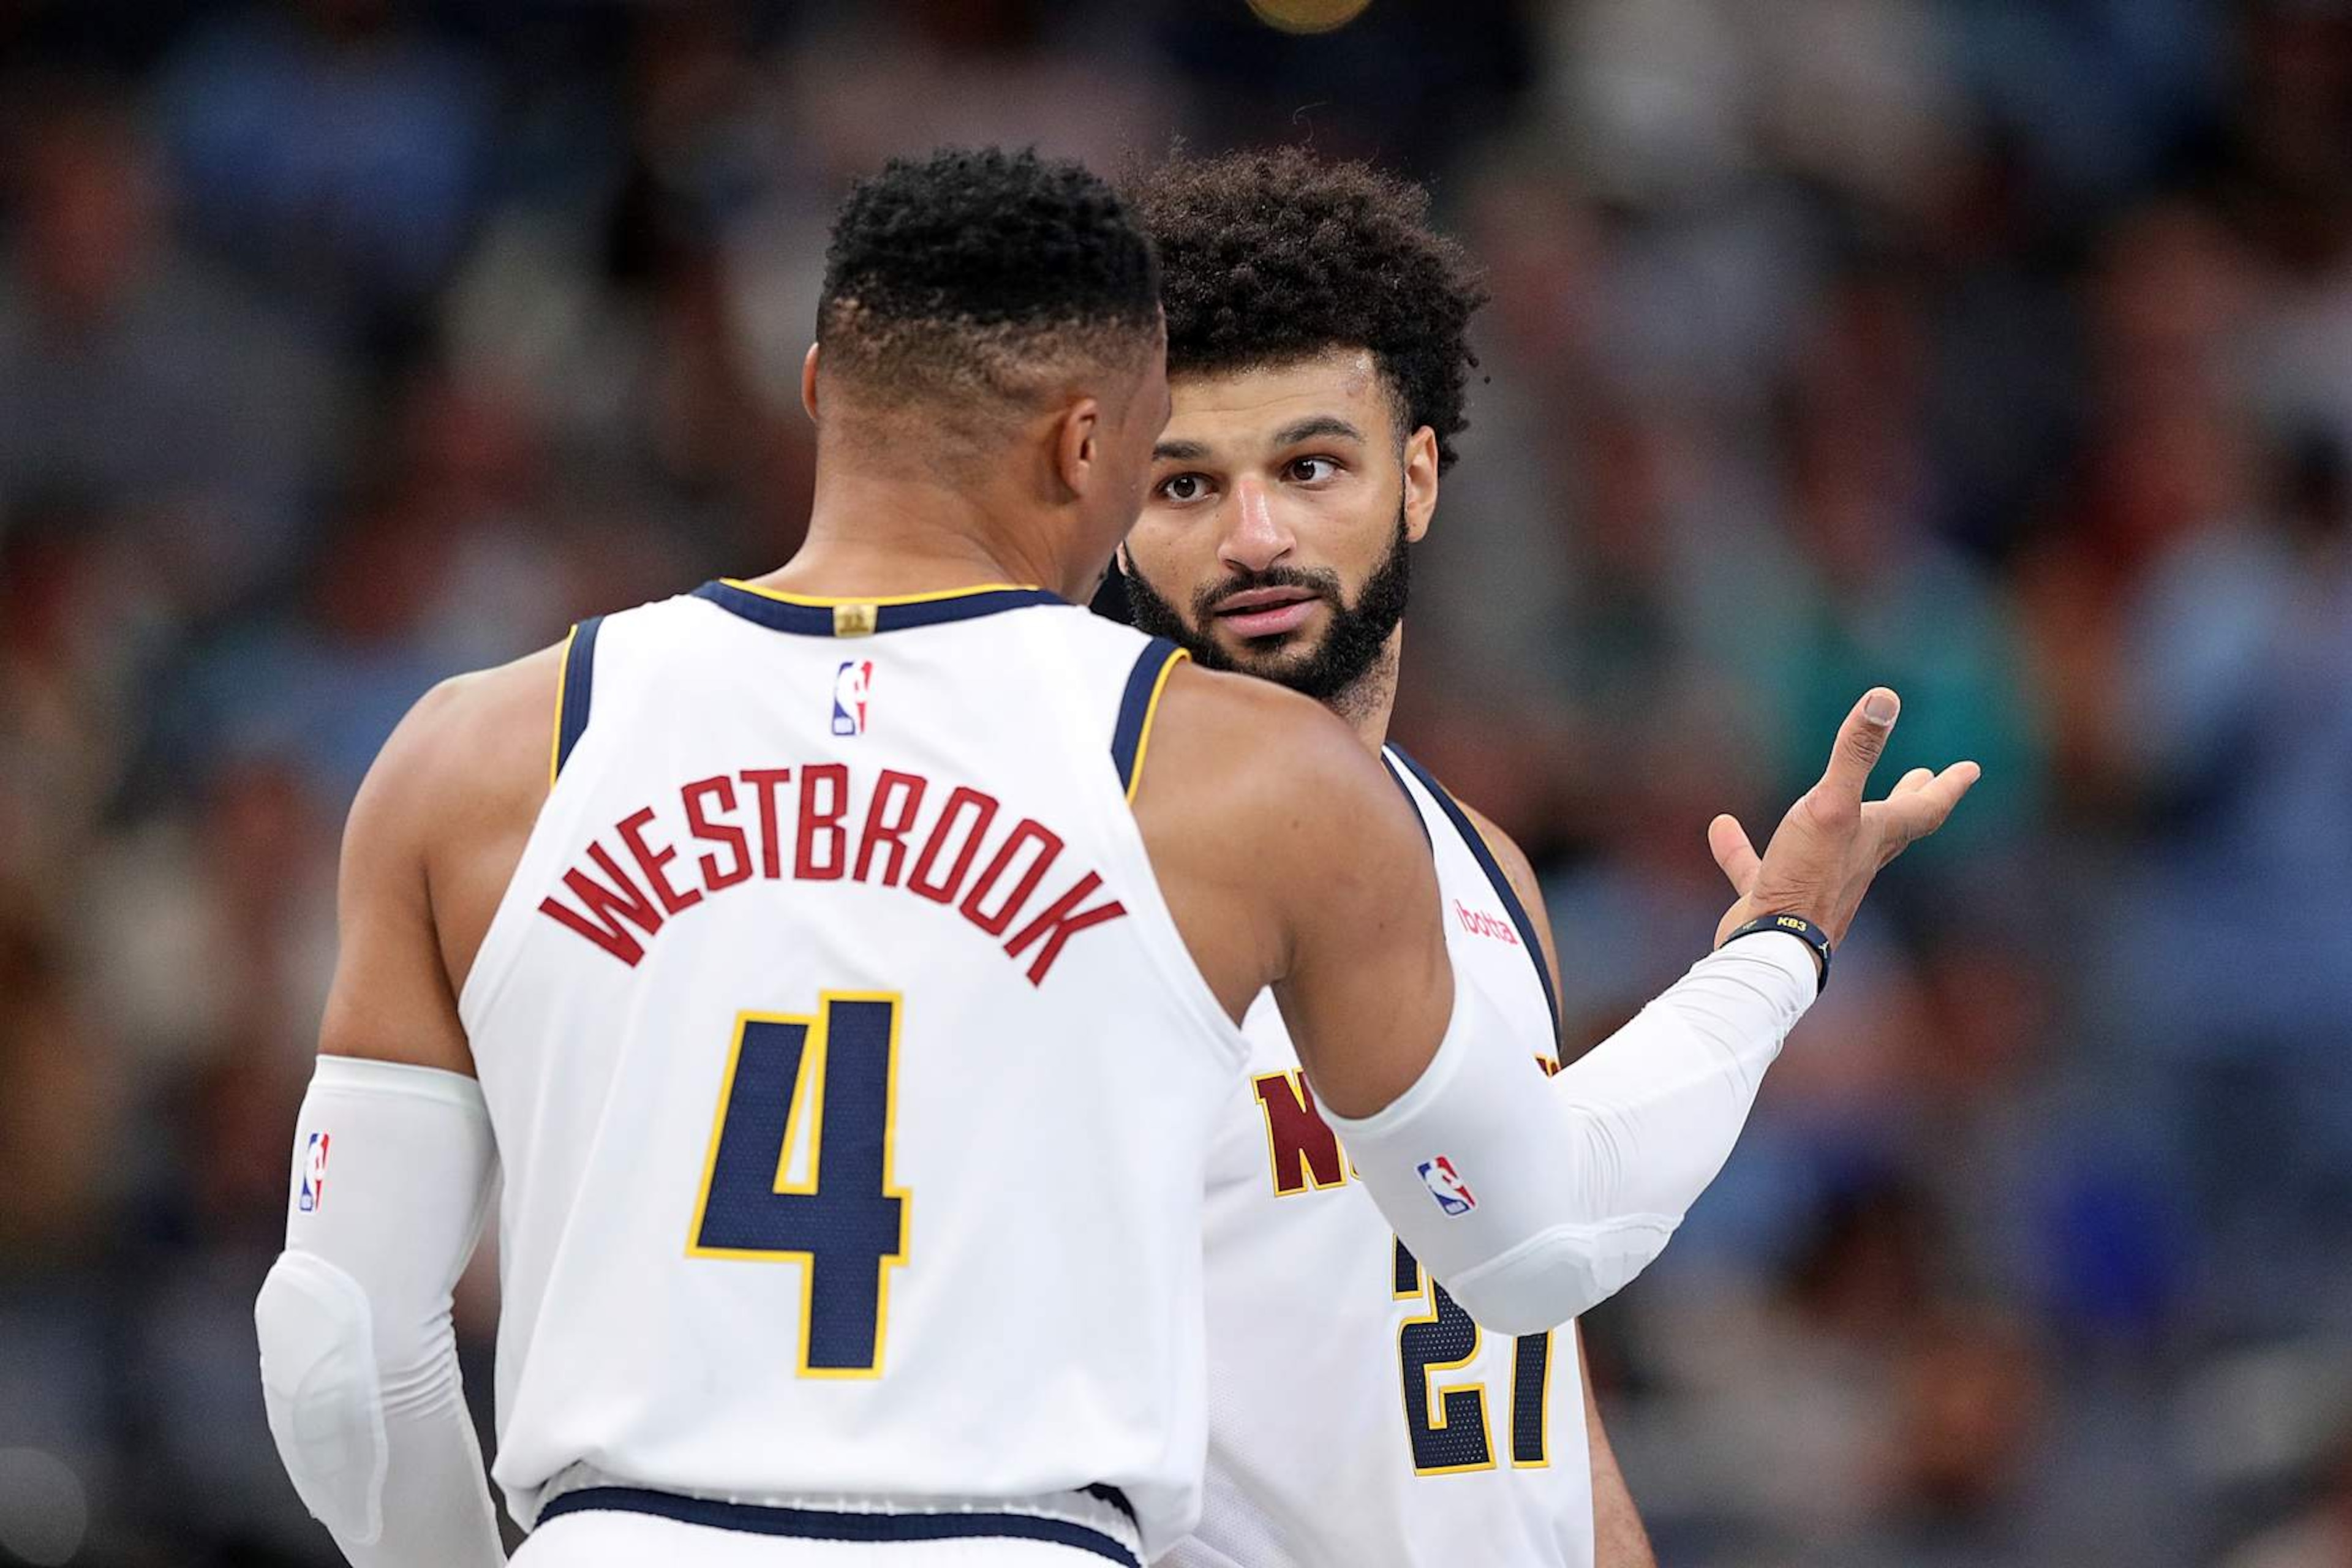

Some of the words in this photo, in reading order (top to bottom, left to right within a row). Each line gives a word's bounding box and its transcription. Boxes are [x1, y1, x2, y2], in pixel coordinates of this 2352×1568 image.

[538, 763, 1127, 988] WESTBROOK
[1777, 916, 1807, 932] KB3
[684, 989, 912, 1379] 4
